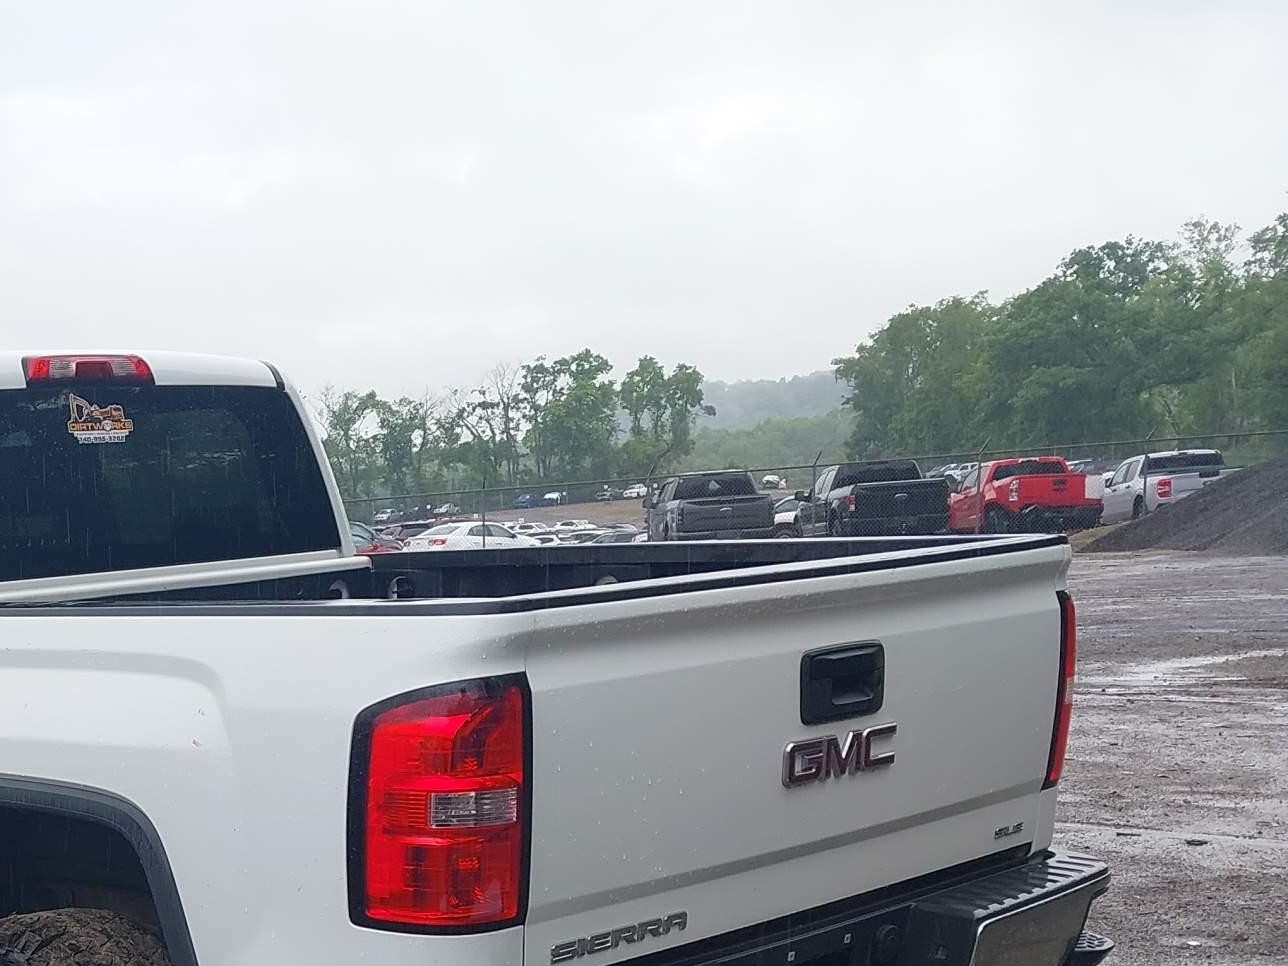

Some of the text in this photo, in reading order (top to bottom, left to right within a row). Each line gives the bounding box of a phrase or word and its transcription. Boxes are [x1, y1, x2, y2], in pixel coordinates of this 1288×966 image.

[782, 722, 897, 788] GMC
[994, 821, 1024, 840] SLE
[550, 910, 688, 965] SIERRA
